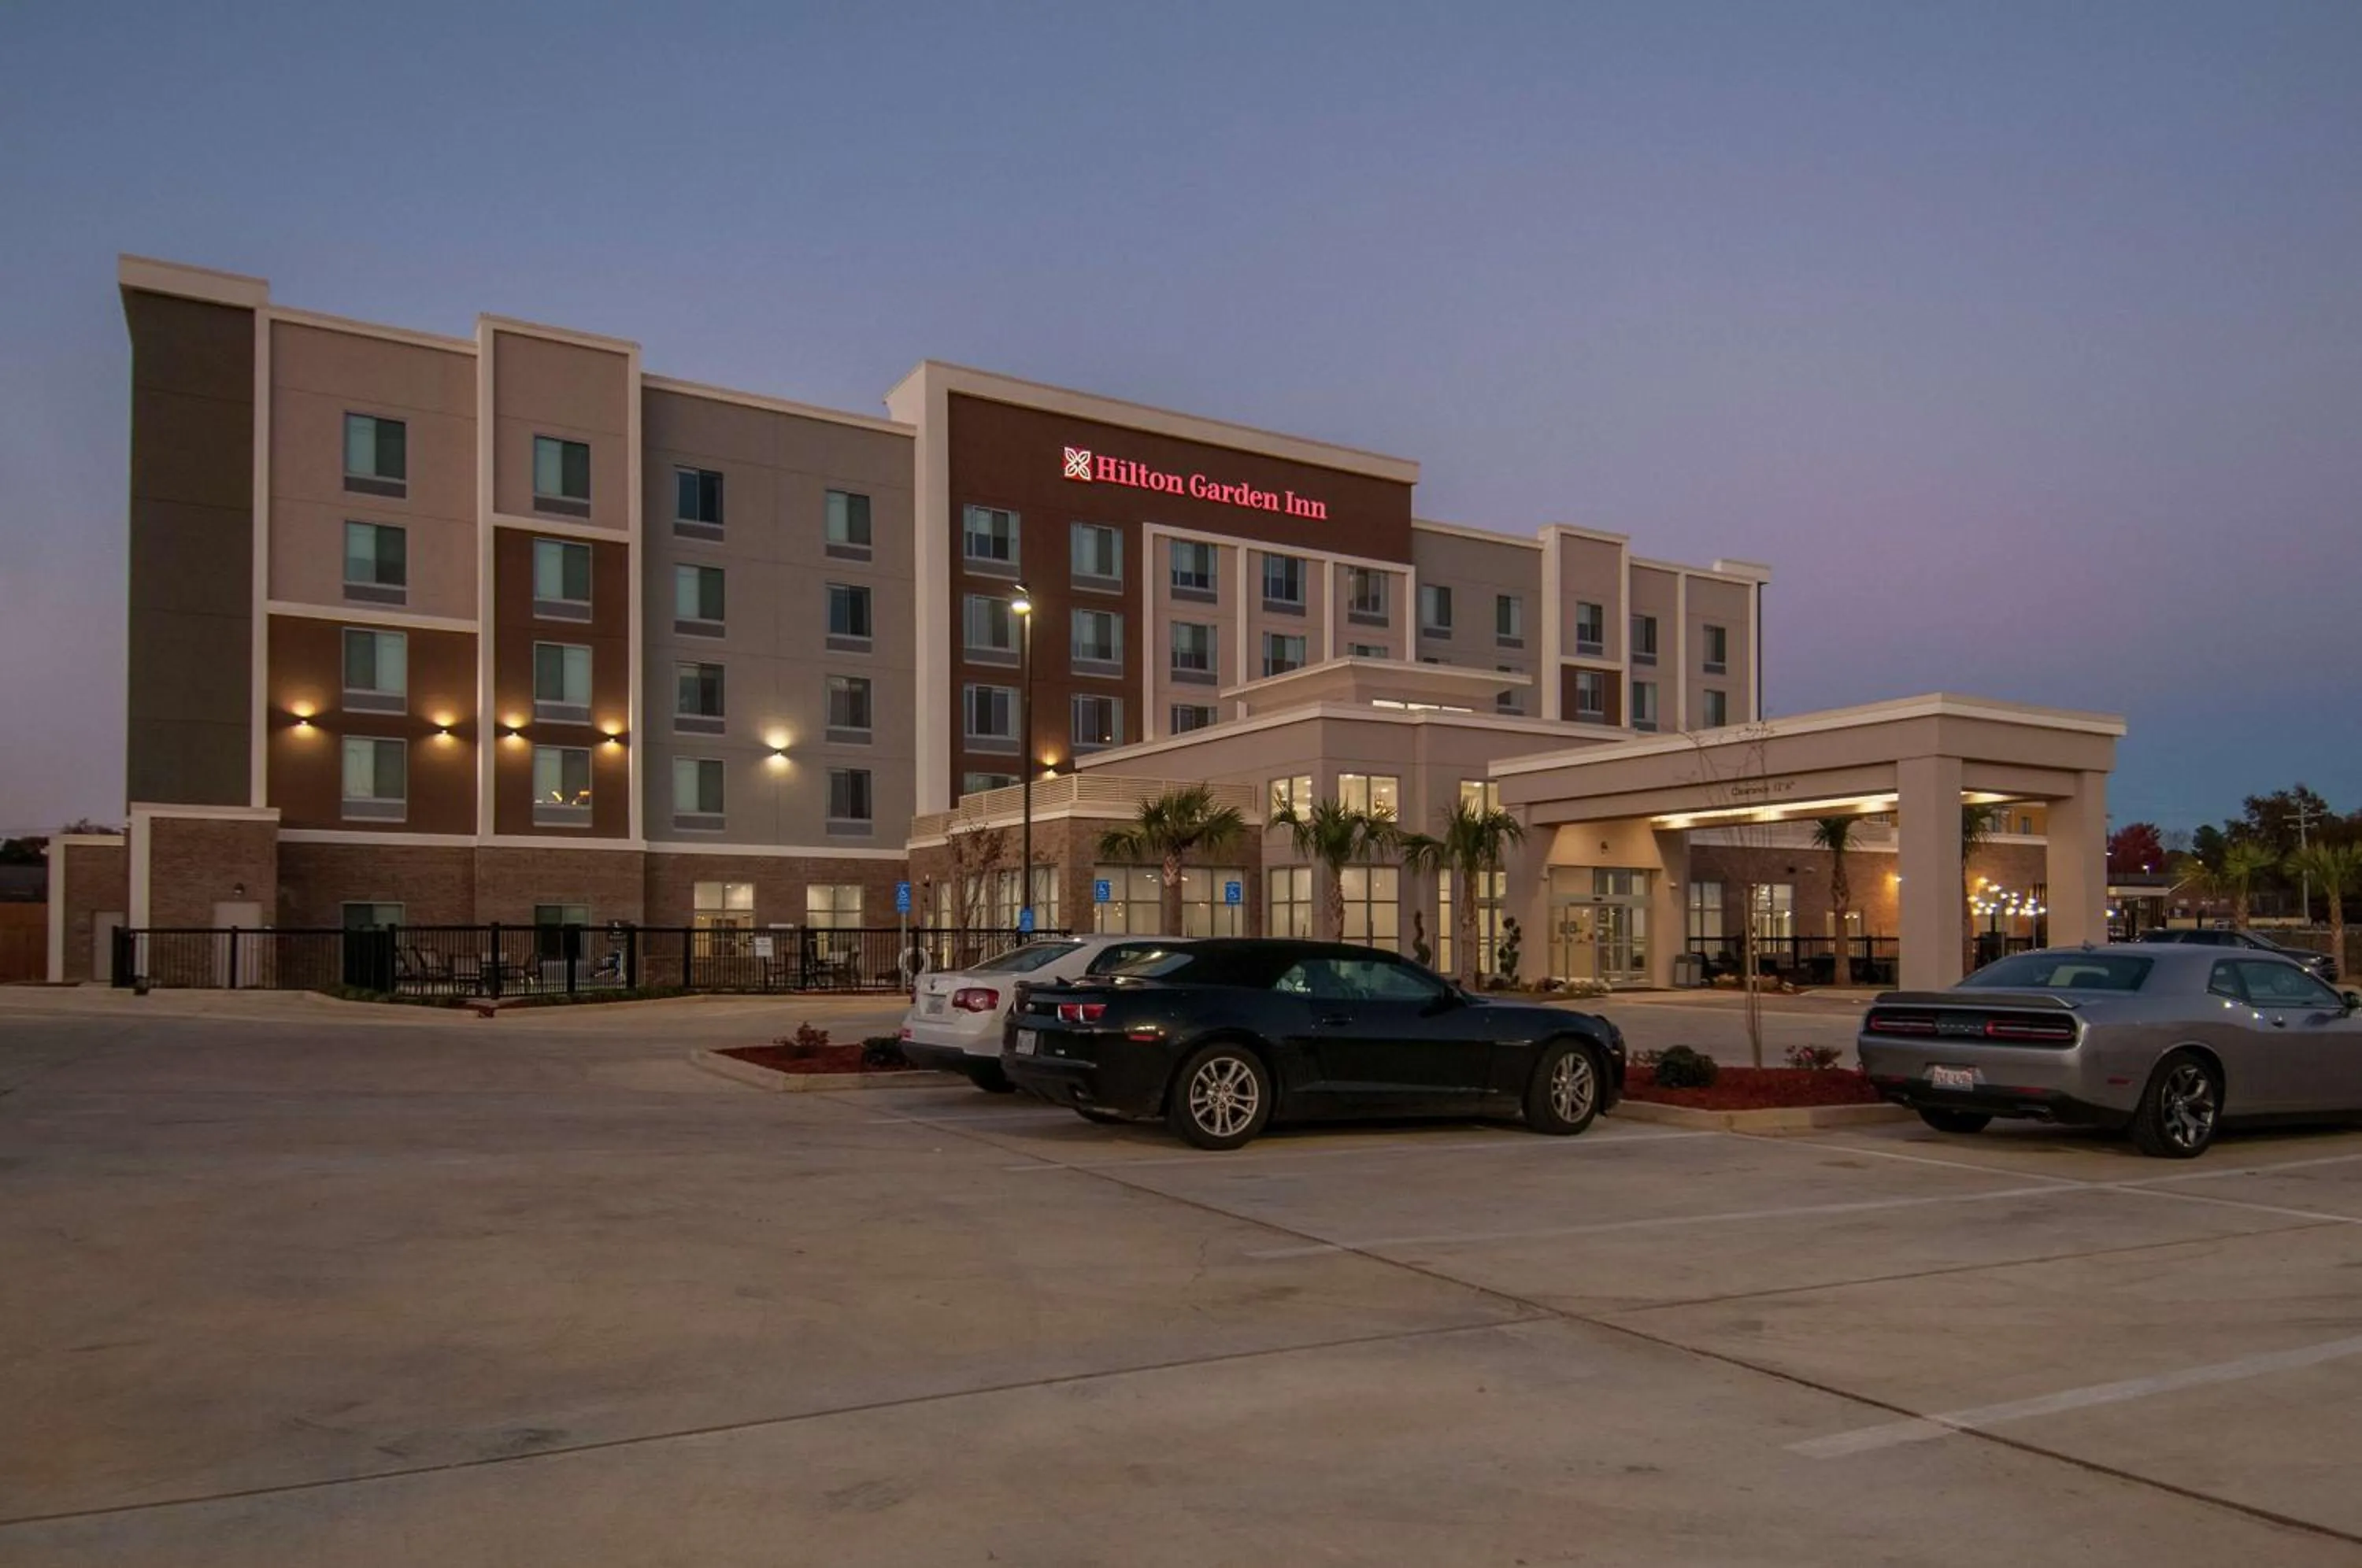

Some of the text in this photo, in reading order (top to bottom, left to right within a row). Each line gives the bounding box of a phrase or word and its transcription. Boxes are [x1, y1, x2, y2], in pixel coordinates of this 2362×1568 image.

[1095, 454, 1327, 520] Hilton Garden Inn
